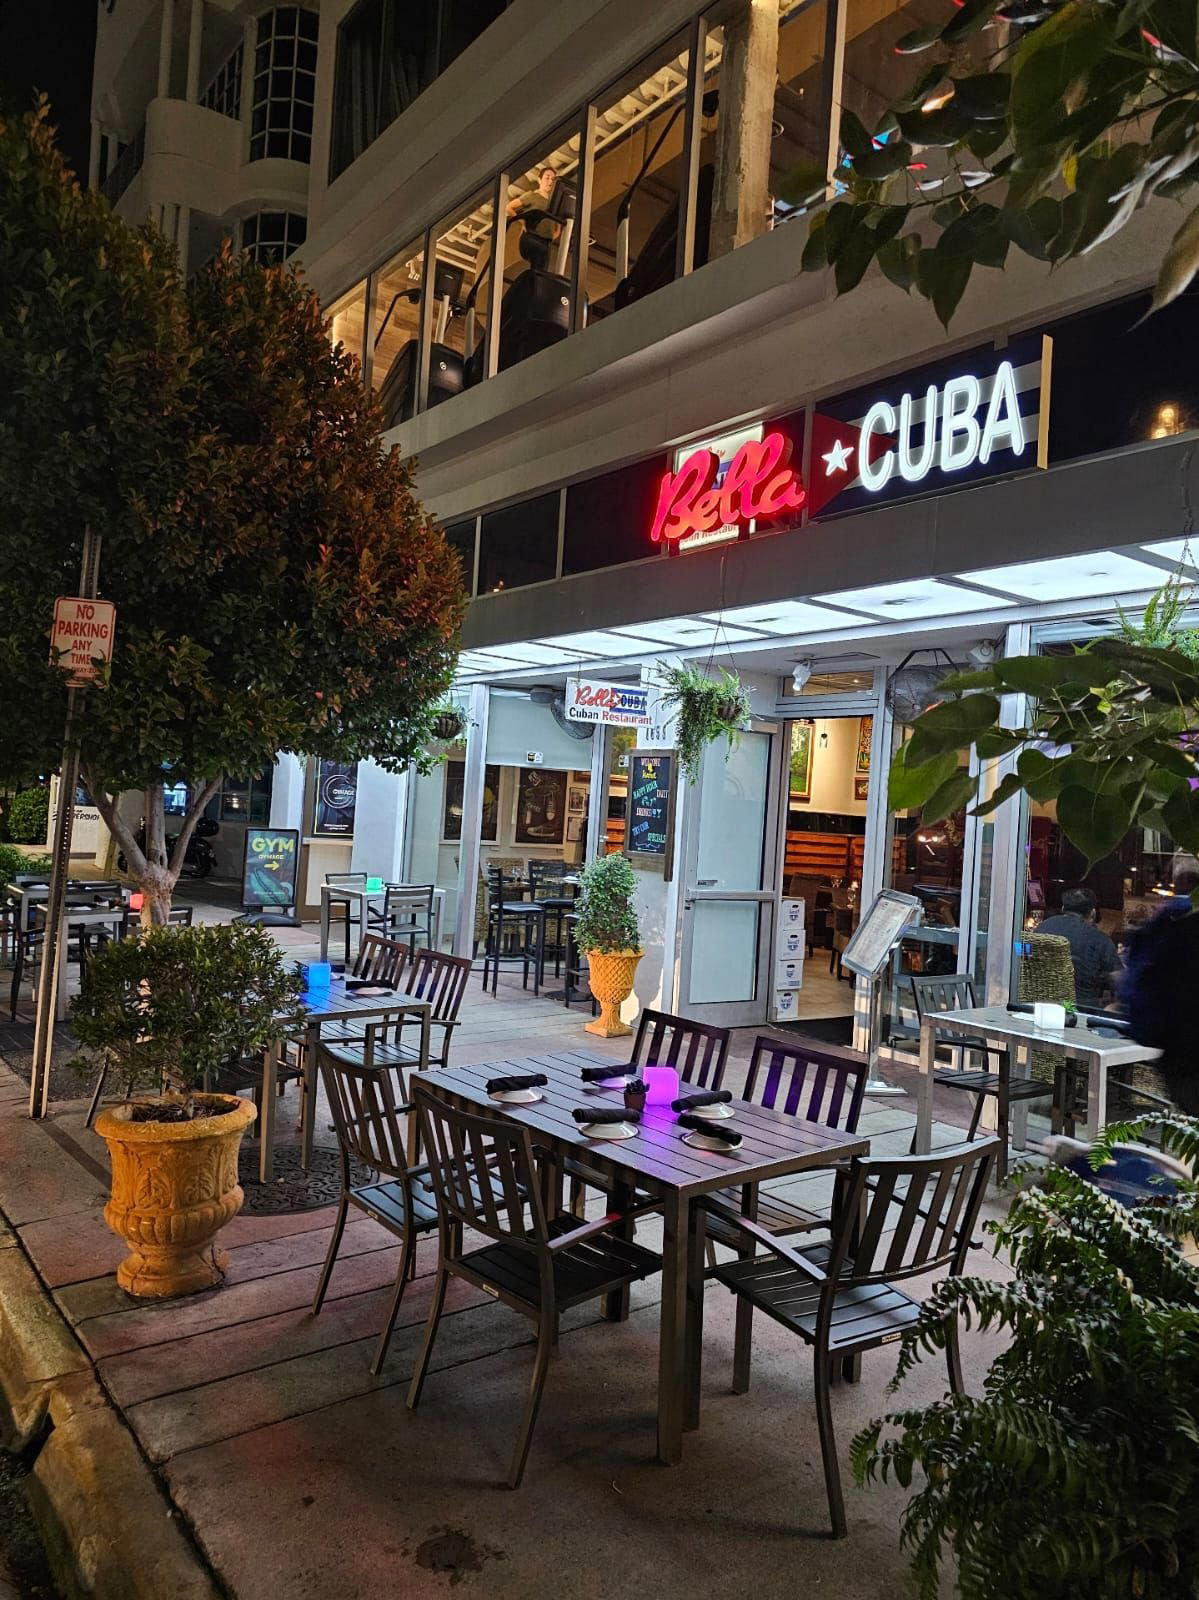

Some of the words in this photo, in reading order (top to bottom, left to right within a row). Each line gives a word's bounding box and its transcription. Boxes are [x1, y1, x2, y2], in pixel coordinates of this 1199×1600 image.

[651, 432, 806, 542] Bella
[858, 360, 1026, 491] CUBA
[76, 604, 95, 620] NO
[58, 620, 109, 639] PARKING
[72, 640, 93, 651] ANY
[71, 653, 91, 665] TIME
[620, 694, 648, 710] CUBA
[569, 706, 599, 720] Cuban
[602, 710, 652, 725] Restaurant
[252, 838, 295, 853] GYM
